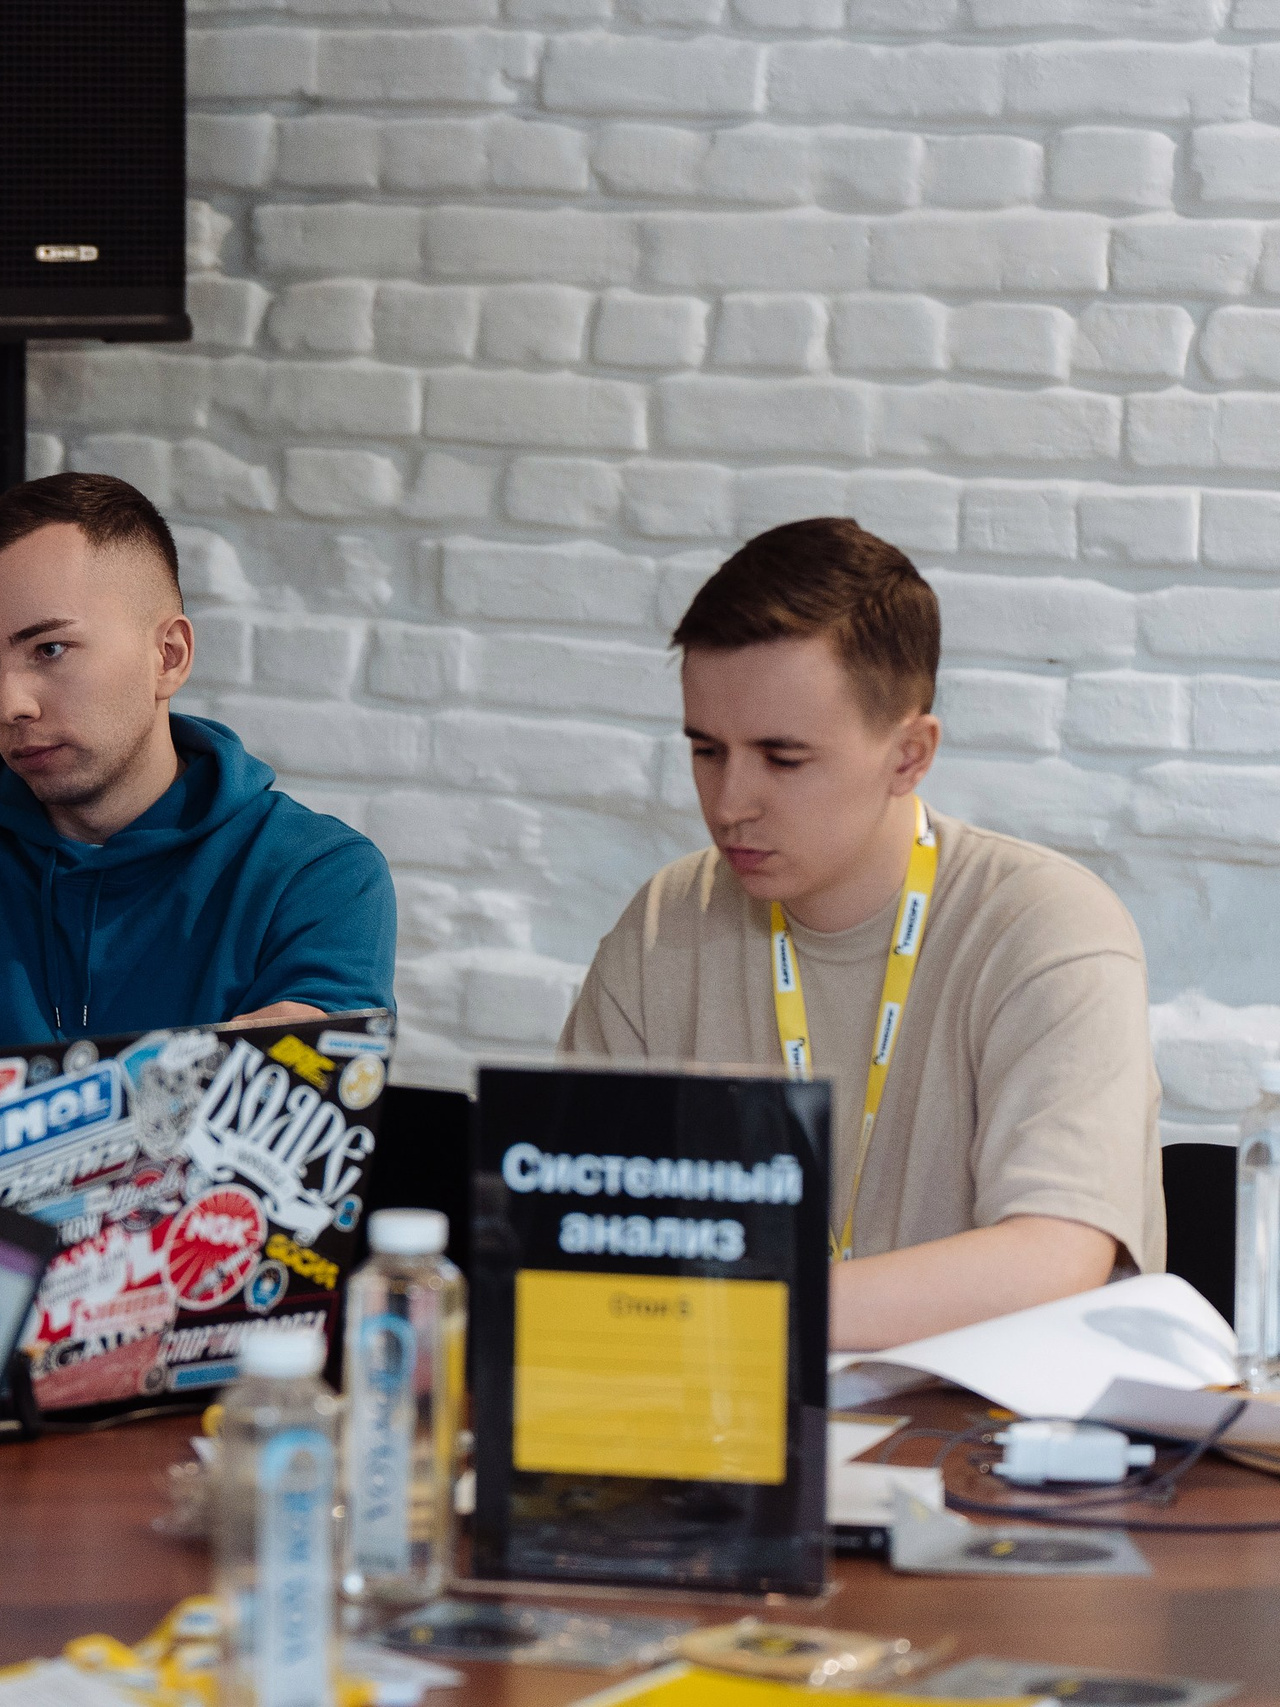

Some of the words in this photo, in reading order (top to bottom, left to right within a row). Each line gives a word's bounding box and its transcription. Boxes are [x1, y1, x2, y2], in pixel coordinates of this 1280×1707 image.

[502, 1142, 803, 1205] Системный
[184, 1211, 255, 1248] NGK
[558, 1212, 746, 1262] анализ
